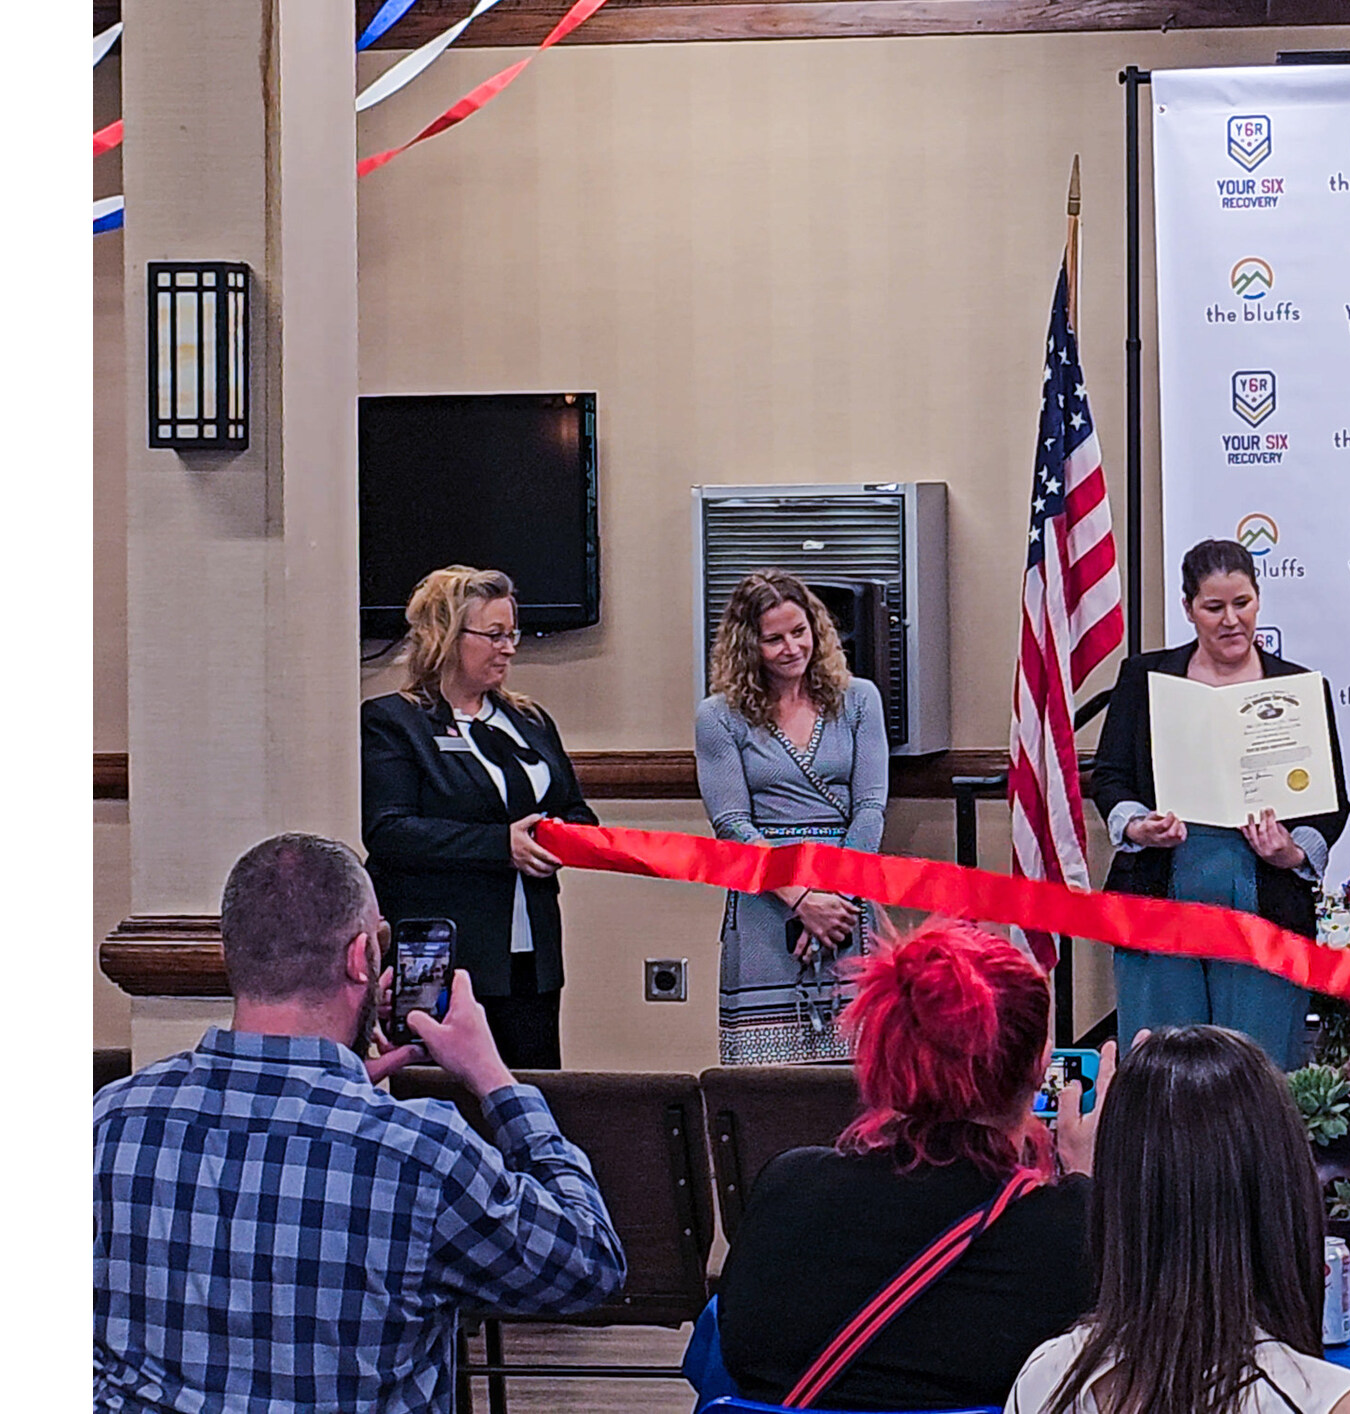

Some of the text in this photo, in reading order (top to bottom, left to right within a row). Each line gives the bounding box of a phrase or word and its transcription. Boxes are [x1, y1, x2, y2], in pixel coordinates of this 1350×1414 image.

[1236, 122, 1262, 136] Y6R
[1217, 179, 1283, 195] YOUR SIX
[1222, 196, 1278, 208] RECOVERY
[1207, 302, 1300, 322] the bluffs
[1240, 378, 1267, 392] Y6R
[1223, 434, 1288, 451] YOUR SIX
[1228, 452, 1282, 464] RECOVERY
[1255, 633, 1273, 649] 6R
